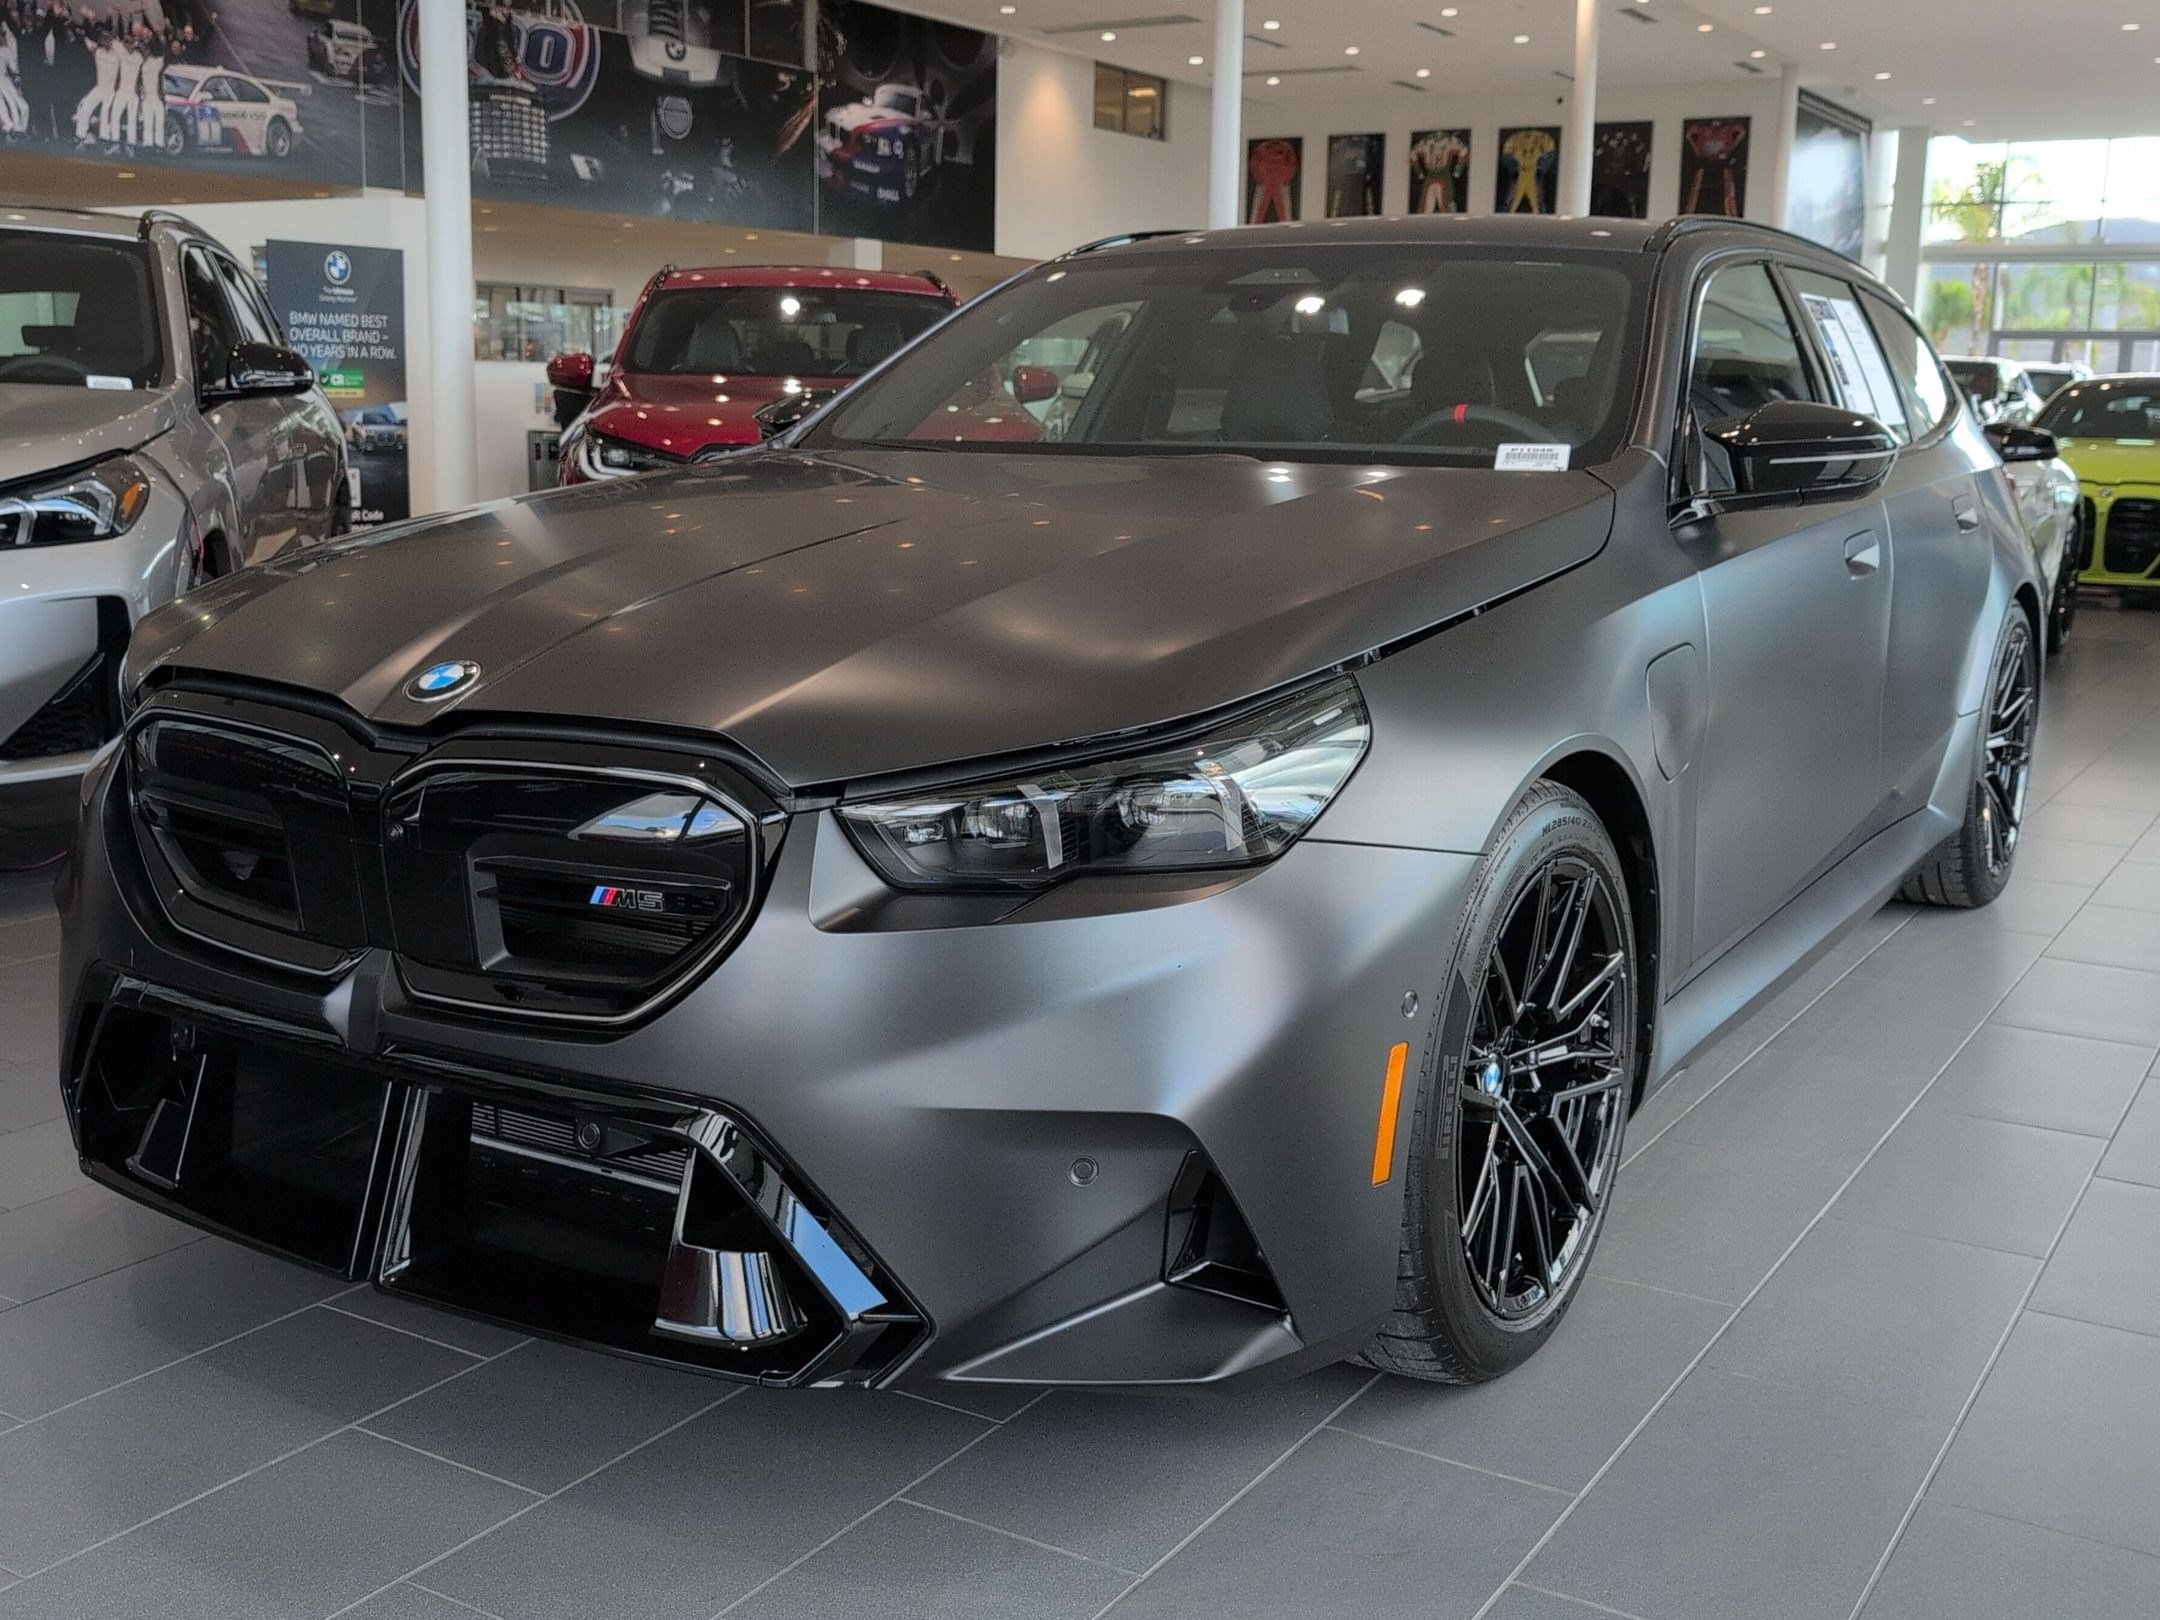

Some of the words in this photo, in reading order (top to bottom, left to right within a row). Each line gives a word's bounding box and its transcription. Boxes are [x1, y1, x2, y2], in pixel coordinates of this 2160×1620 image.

[289, 311, 318, 325] BMW
[319, 312, 360, 328] NAMED
[361, 314, 388, 329] BEST
[290, 327, 341, 342] OVERALL
[342, 328, 380, 344] BRAND
[309, 344, 346, 359] YEARS
[347, 345, 359, 359] IN
[360, 346, 369, 359] A
[362, 509, 384, 521] Code
[611, 887, 663, 912] M5
